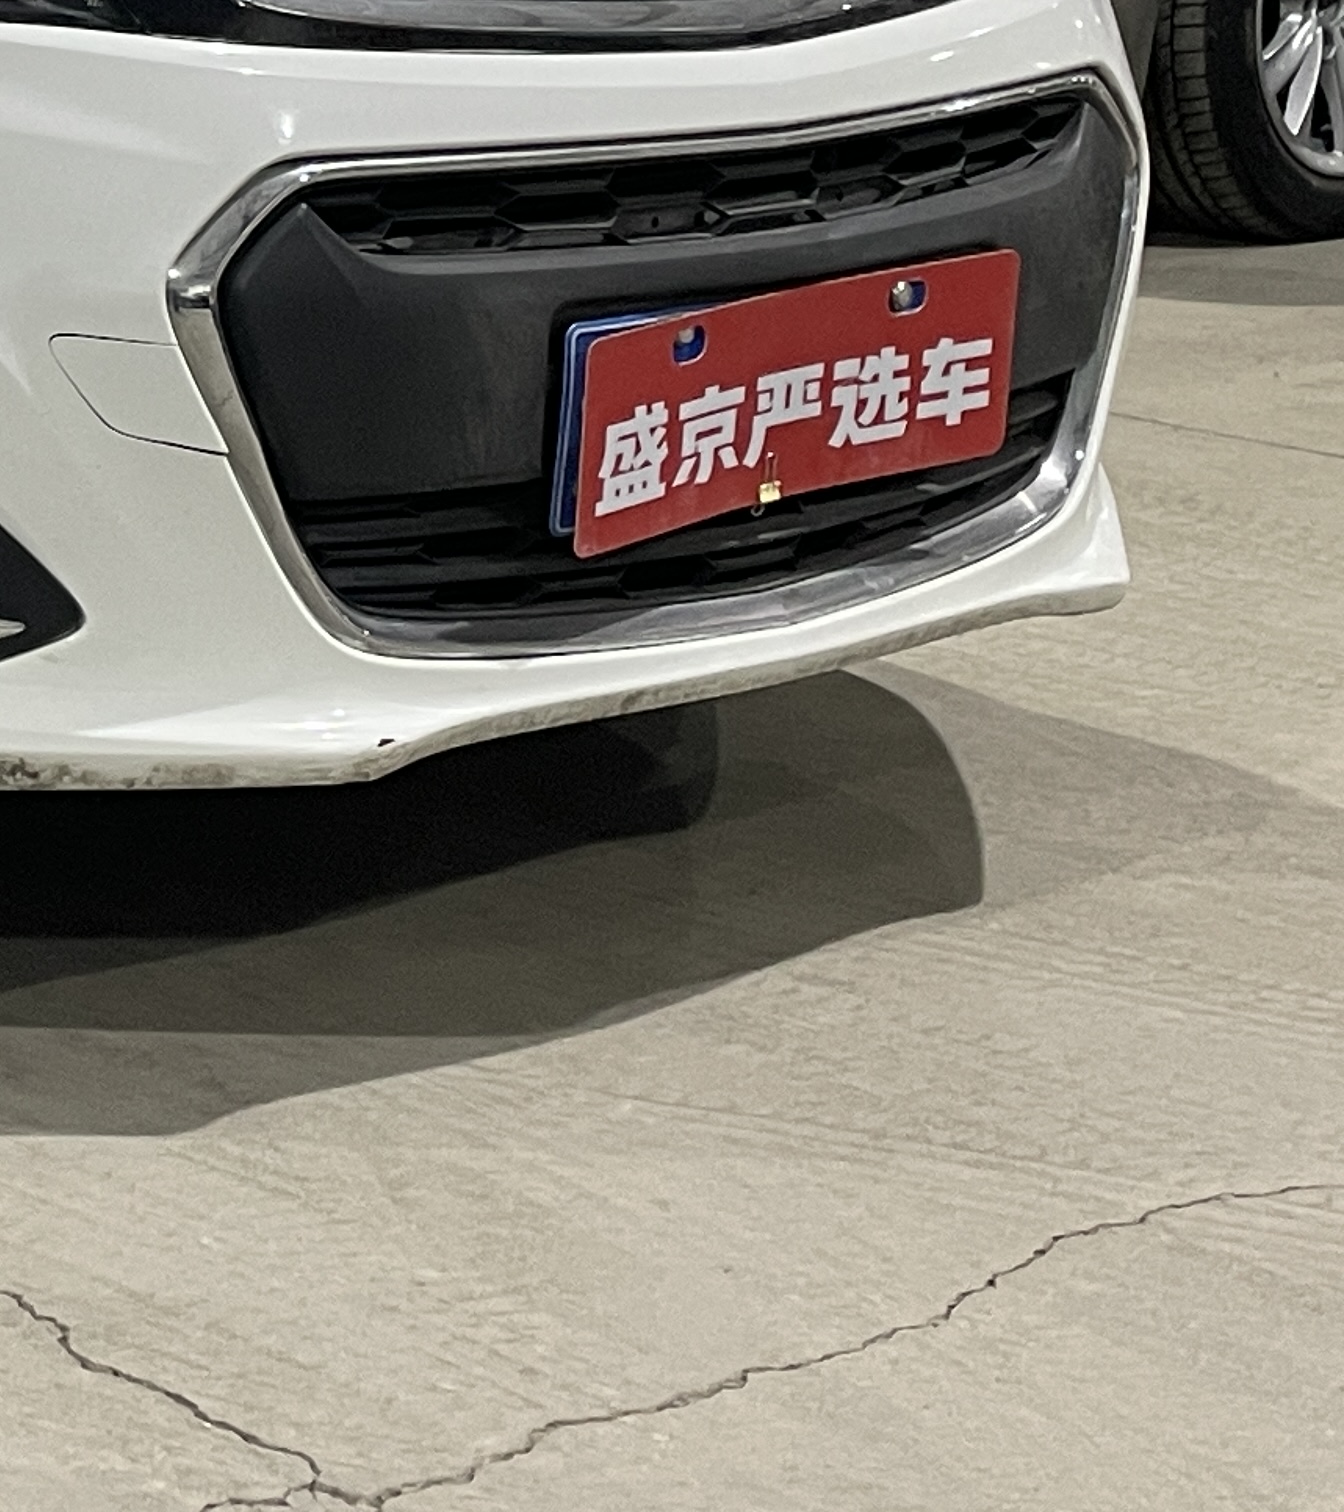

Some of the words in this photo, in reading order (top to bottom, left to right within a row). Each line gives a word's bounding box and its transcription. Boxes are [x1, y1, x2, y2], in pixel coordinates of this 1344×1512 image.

[594, 337, 994, 517] 盛京严选车
